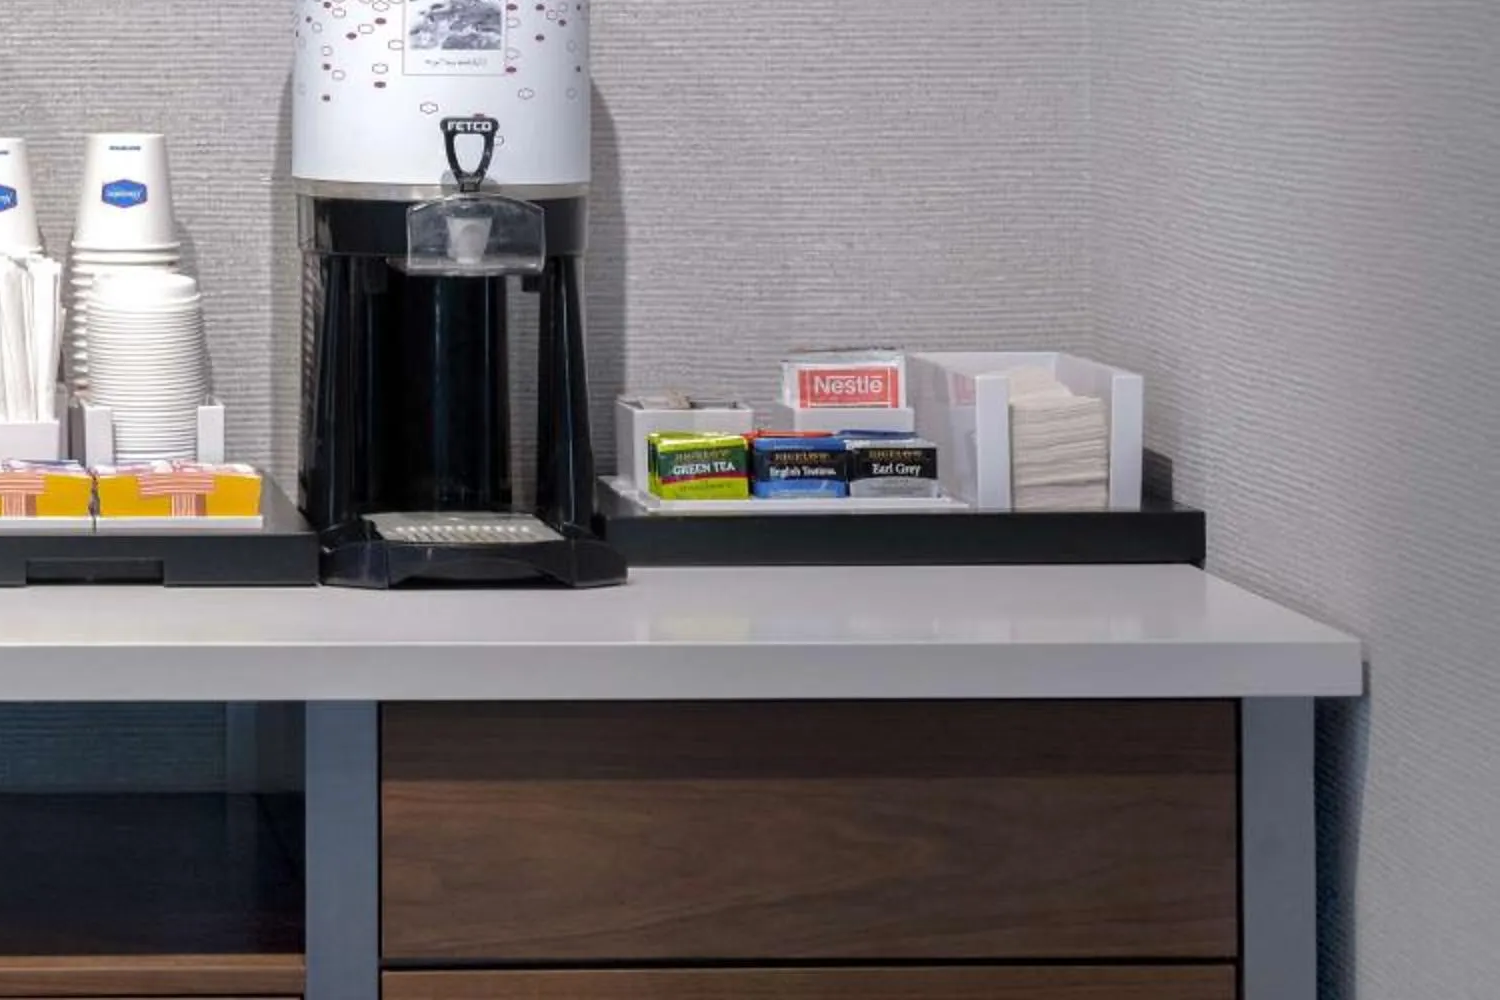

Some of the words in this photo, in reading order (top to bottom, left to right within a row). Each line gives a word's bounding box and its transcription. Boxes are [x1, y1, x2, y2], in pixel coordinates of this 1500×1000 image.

[447, 121, 492, 131] FETCO
[673, 463, 710, 476] GREEN
[712, 461, 736, 473] TEA
[871, 463, 893, 475] Earl
[895, 463, 921, 477] Grey
